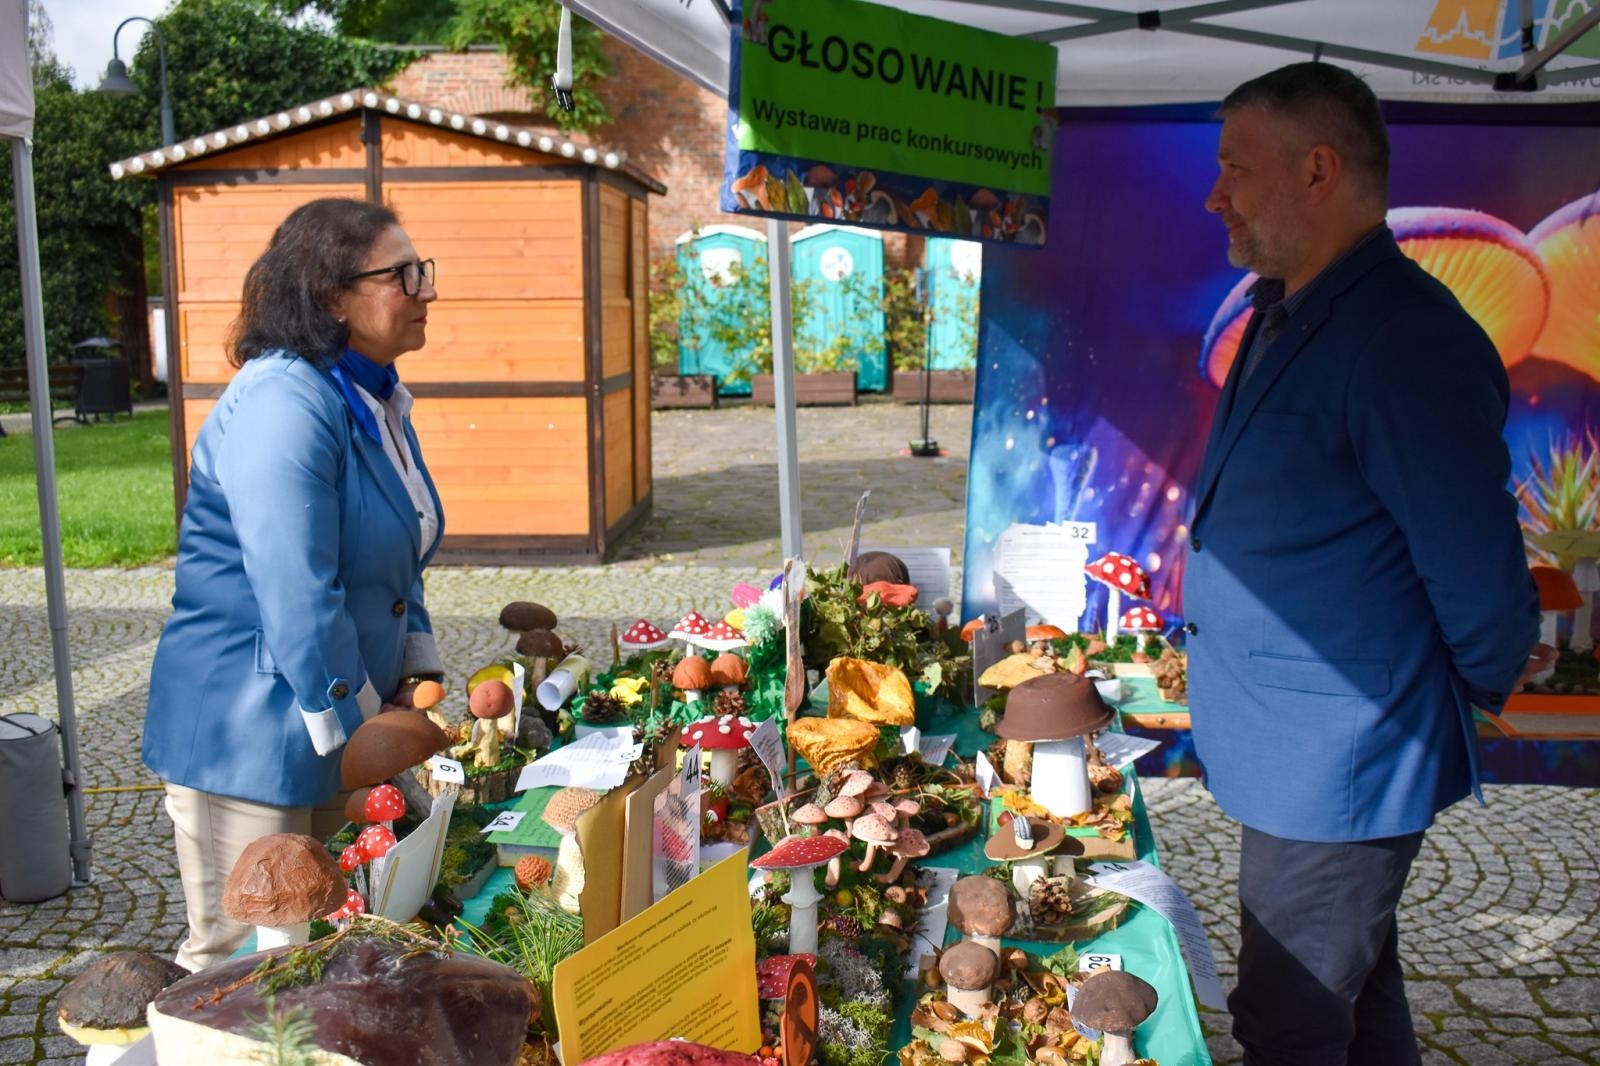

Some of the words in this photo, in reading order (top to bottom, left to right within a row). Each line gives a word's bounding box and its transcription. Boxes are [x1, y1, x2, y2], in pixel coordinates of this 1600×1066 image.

[767, 24, 1028, 111] GŁOSOWANIE
[752, 98, 851, 136] Wystawa
[856, 121, 902, 146] prac
[907, 128, 1043, 171] konkursowych
[1071, 526, 1089, 539] 32
[686, 753, 699, 784] 44
[1103, 862, 1129, 873] 14
